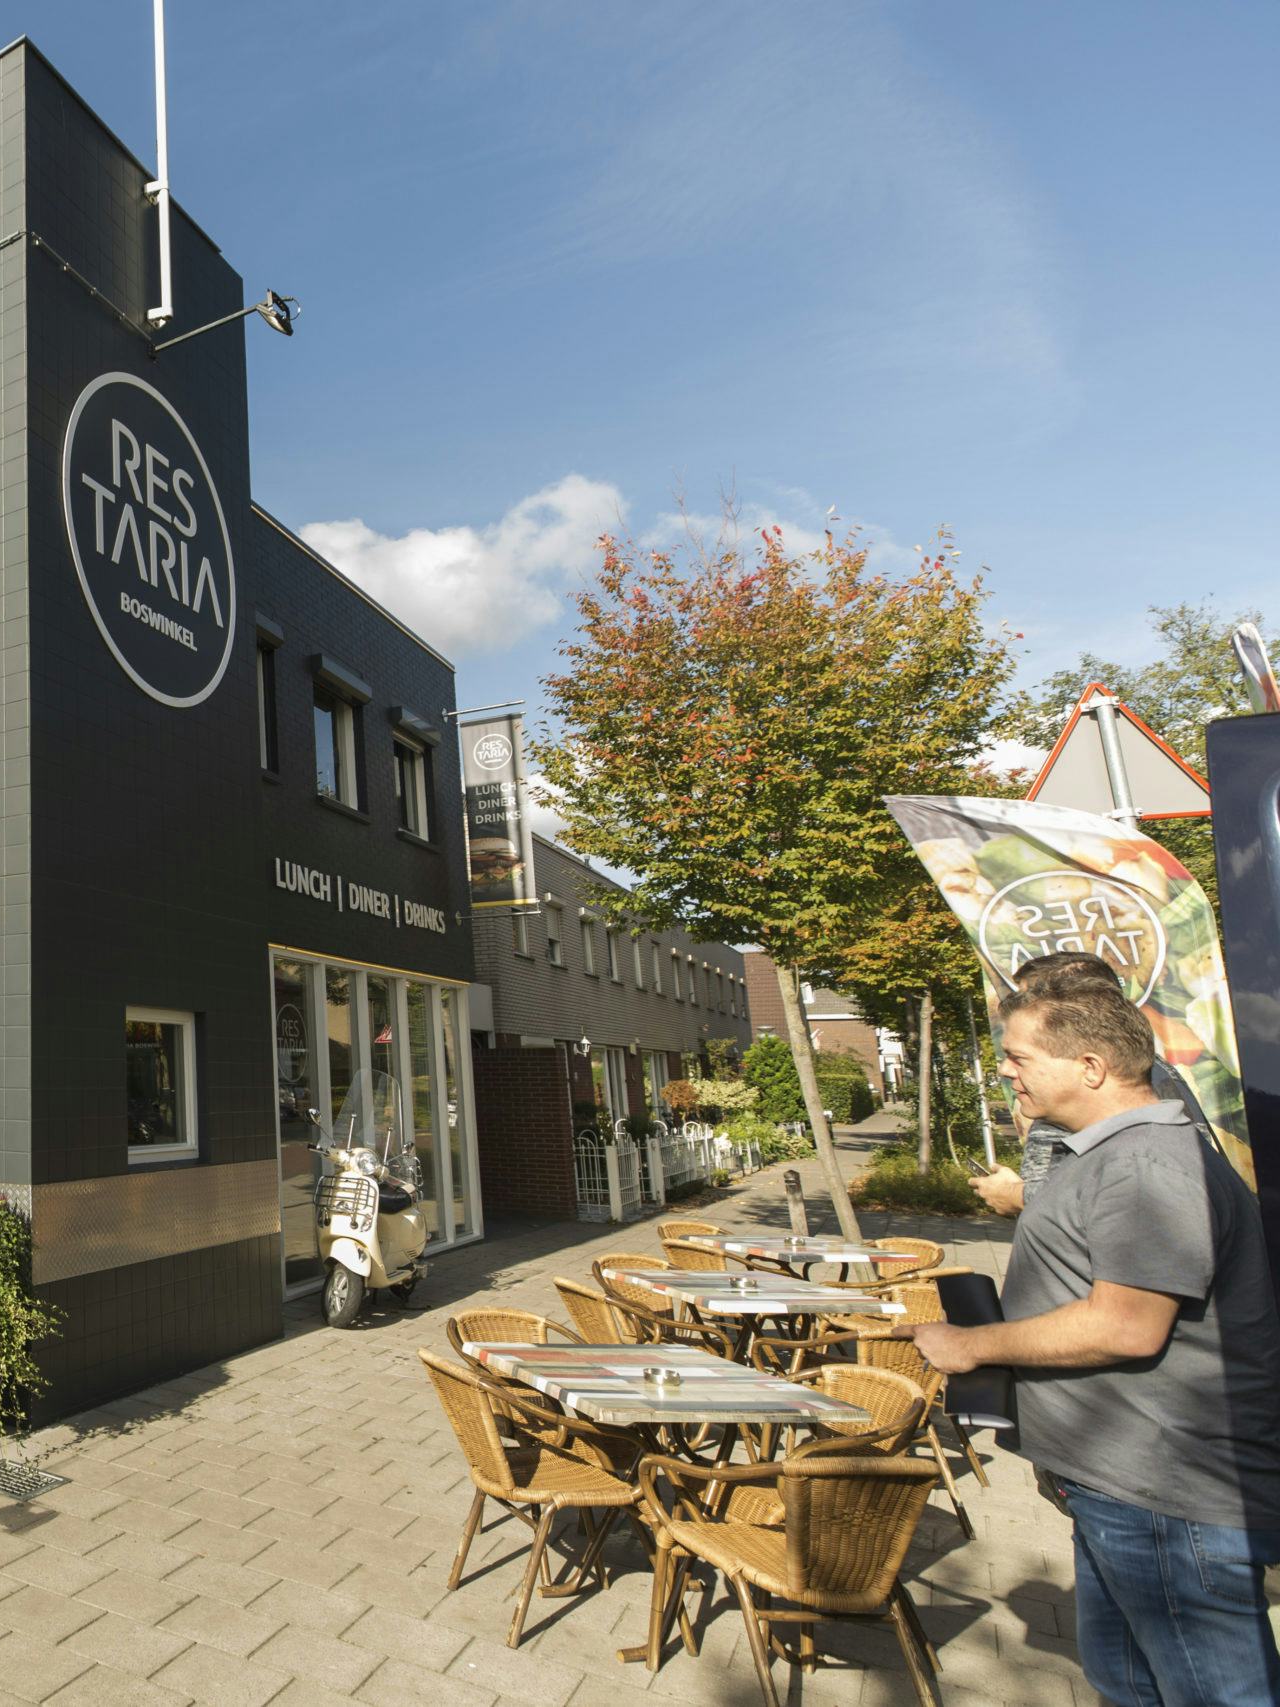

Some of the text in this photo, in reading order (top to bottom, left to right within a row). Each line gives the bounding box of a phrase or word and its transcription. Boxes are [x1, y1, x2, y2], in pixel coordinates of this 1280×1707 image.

[112, 418, 197, 537] RES
[82, 472, 224, 628] TARIA
[120, 591, 198, 652] BOSWINKEL
[477, 747, 509, 760] TARIA
[481, 740, 503, 751] RES
[475, 782, 517, 795] LUNCH
[478, 796, 516, 810] DINER
[475, 810, 522, 824] DRINKS
[275, 857, 332, 902] LUNCH
[348, 882, 391, 919] DINER
[404, 900, 446, 934] DRINKS
[281, 1018, 300, 1038] RES
